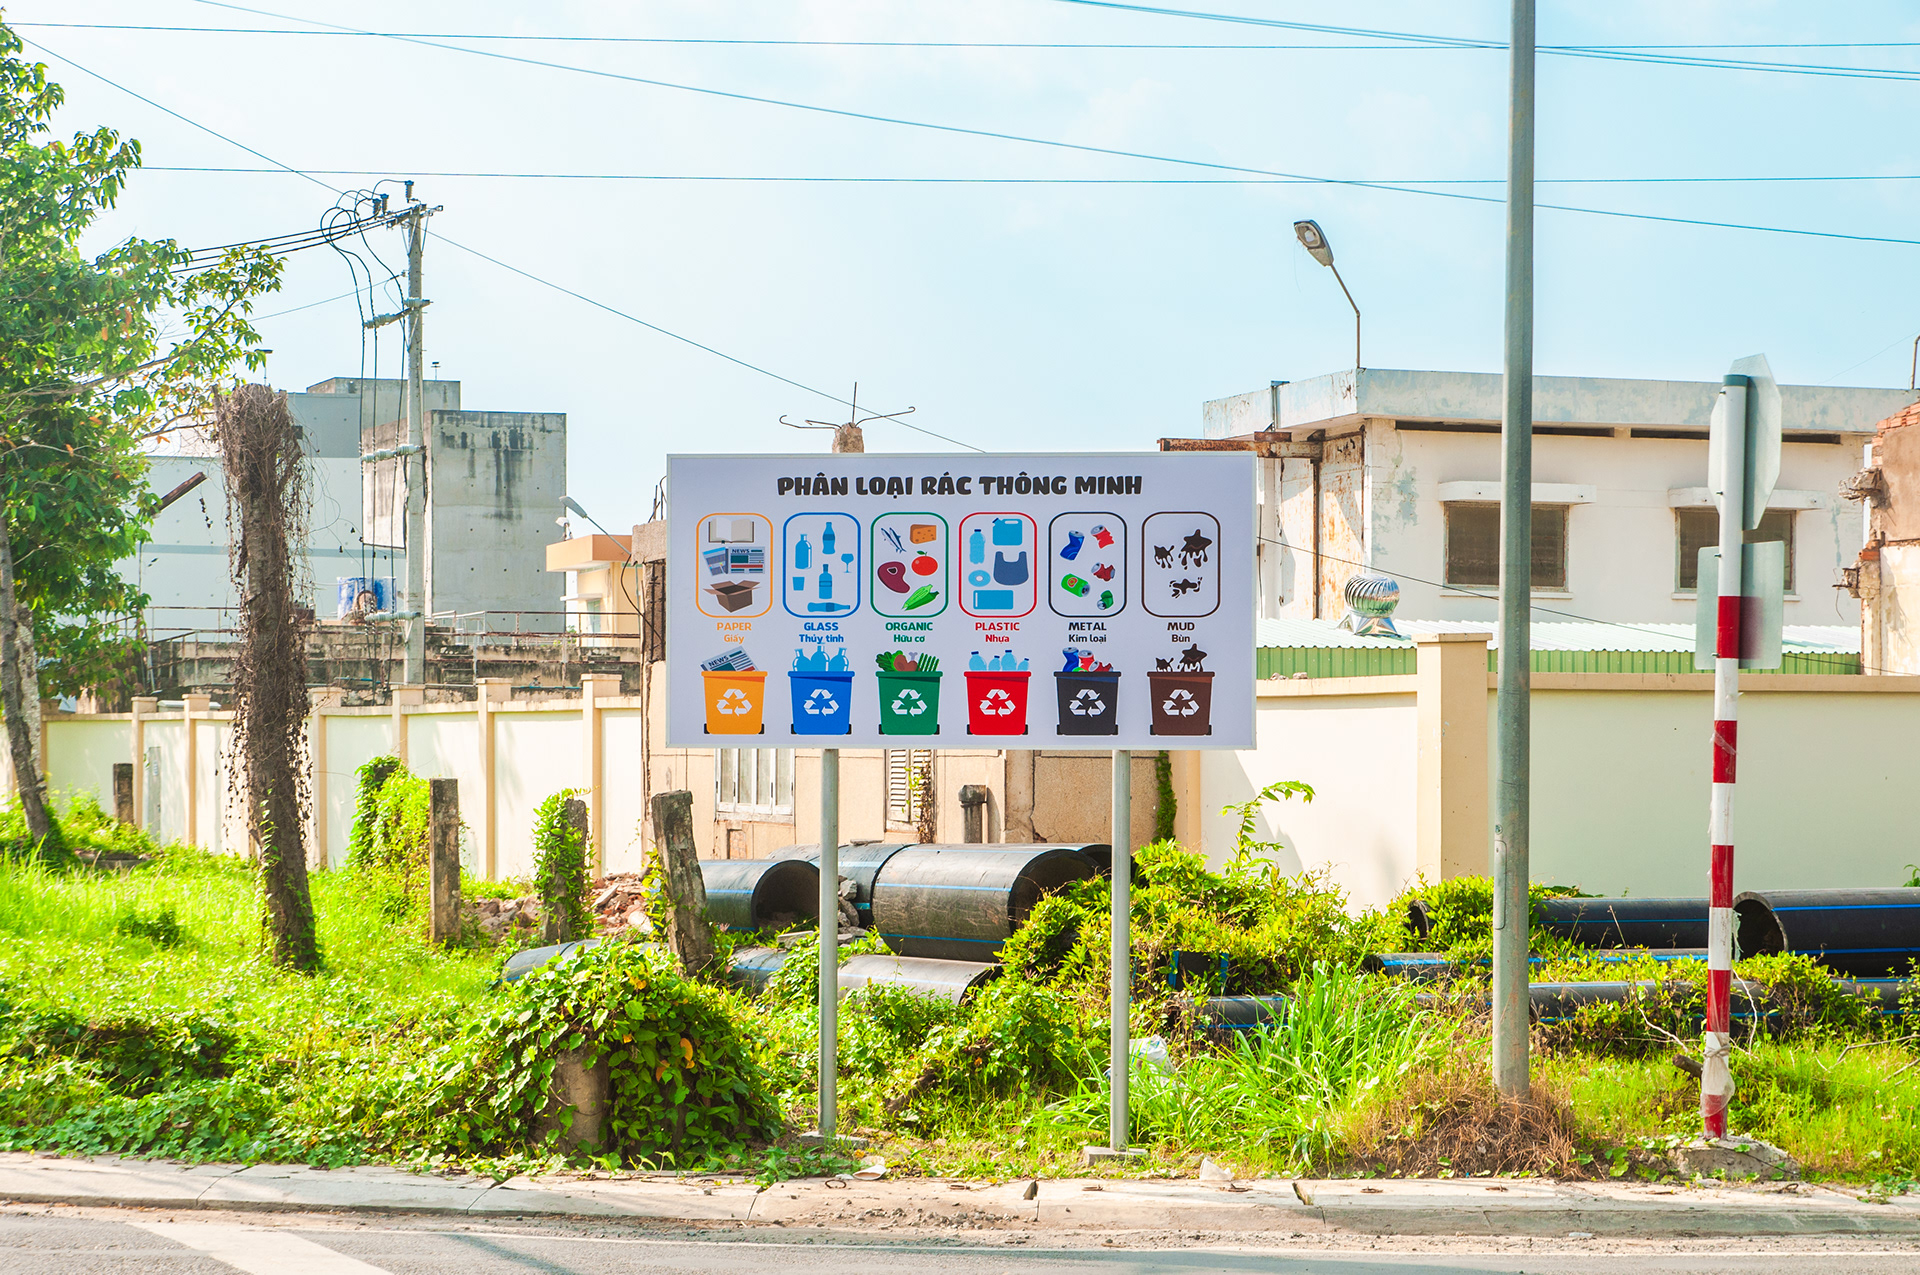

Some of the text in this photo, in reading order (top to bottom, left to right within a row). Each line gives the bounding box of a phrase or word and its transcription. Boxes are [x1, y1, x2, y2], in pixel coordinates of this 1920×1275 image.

[778, 472, 1142, 499] PHÂN LOẠI RÁC THÔNG MINH
[717, 623, 752, 631] PAPER
[804, 622, 839, 631] GLASS
[885, 622, 933, 631] ORGANIC
[975, 622, 1020, 631] PLASTIC
[1068, 622, 1107, 631] METAL
[1167, 622, 1195, 631] MUD
[825, 634, 844, 642] tinh
[985, 634, 1010, 644] Nhựa
[1068, 634, 1107, 644] Kim loại
[1171, 634, 1191, 642] Bùn
[708, 655, 729, 667] NEWS
